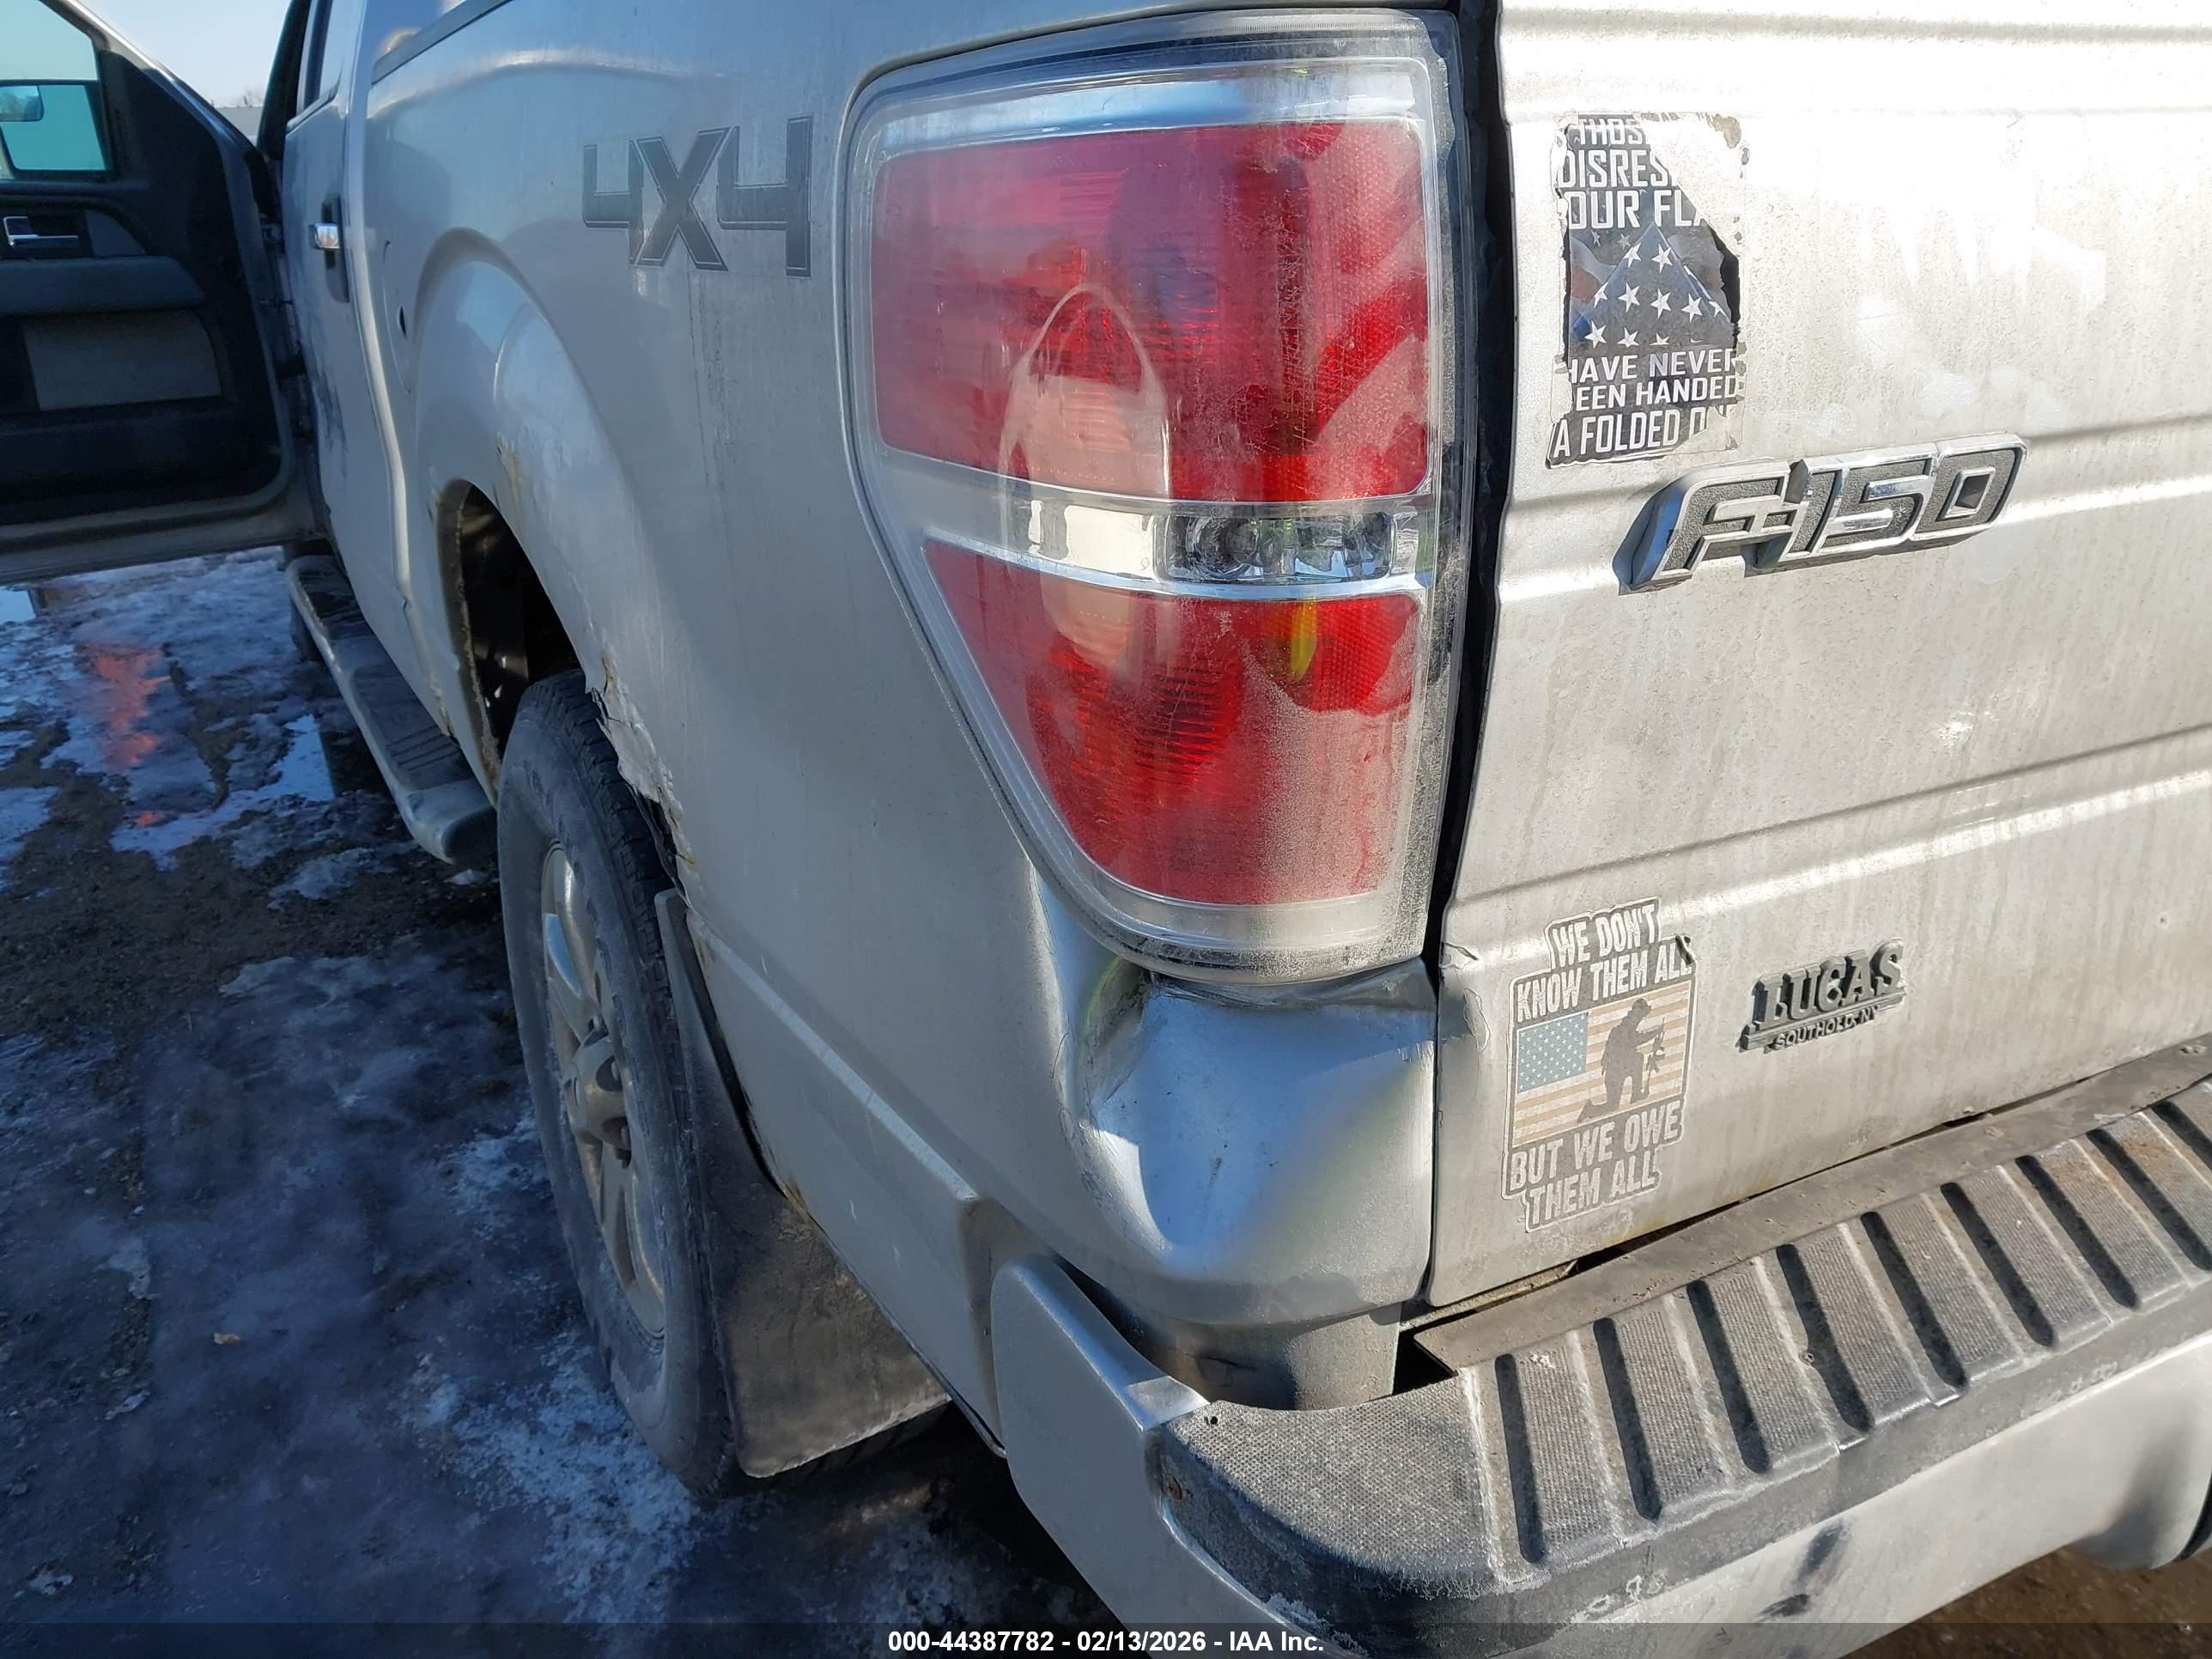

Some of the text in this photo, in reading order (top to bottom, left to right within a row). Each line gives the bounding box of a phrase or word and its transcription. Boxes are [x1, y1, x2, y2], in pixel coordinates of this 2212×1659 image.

[1578, 118, 1647, 145] THOS
[1558, 149, 1677, 188] DISRES
[1564, 189, 1640, 229] OUR
[1636, 375, 1737, 406] HANDED
[1553, 419, 1571, 459] A
[1580, 409, 1680, 456] FOLDED
[1553, 904, 1659, 969] WE DON'T
[1517, 969, 1582, 1024] KNOW
[1590, 949, 1648, 1002] THEM
[1752, 938, 1905, 1028] LUCAS
[1510, 1100, 1681, 1193] BUT WE OWE
[1529, 1151, 1658, 1227] THEM ALL
